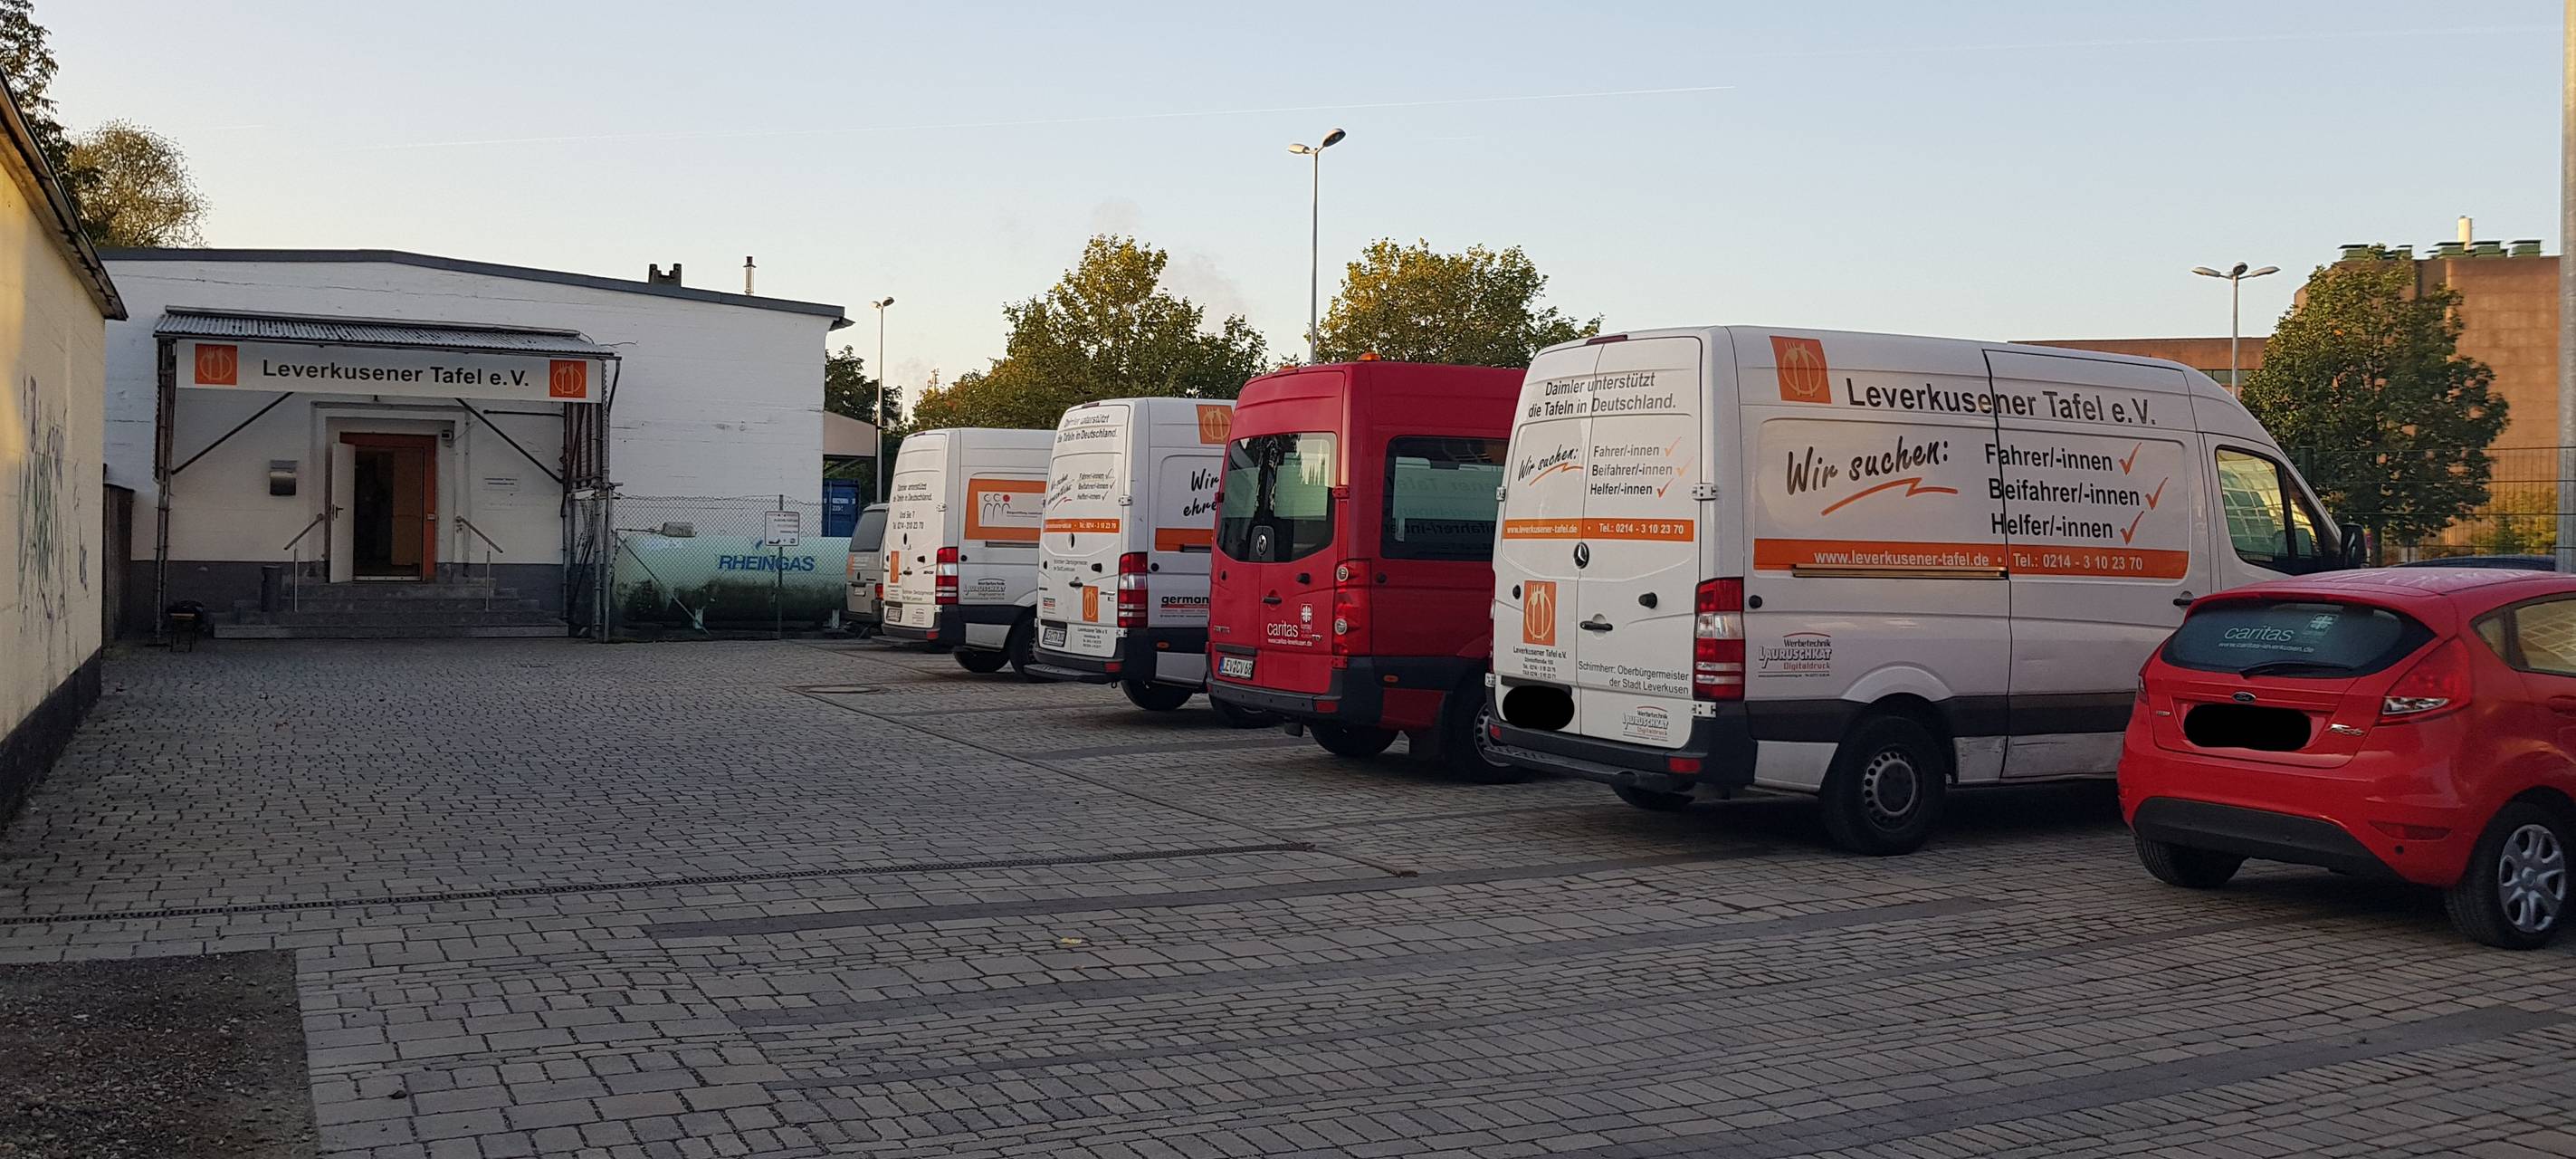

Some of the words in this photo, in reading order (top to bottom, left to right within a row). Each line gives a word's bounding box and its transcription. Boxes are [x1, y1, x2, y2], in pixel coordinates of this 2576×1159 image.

[262, 359, 424, 383] Leverkusener
[430, 366, 482, 385] Tafel
[490, 369, 530, 387] e.V.
[1545, 379, 1589, 397] Daimler
[1588, 372, 1655, 392] unterstützt
[1528, 403, 1541, 418] die
[1544, 400, 1573, 417] Tafeln
[1577, 399, 1587, 414] in
[1592, 393, 1676, 413] Deutschland.
[1846, 378, 2037, 417] Leverkusener
[2042, 390, 2104, 421] Tafel
[2112, 398, 2157, 425] e.V.
[1593, 445, 1659, 457] Fahrer/-innen
[1985, 443, 2113, 471] Fahrer/-innen
[1518, 455, 1535, 482] Wir
[1538, 444, 1579, 471] suchen:
[1592, 464, 1673, 476] Beifahrer/-innen
[1787, 446, 1838, 495] Wir
[1849, 436, 1949, 481] suchen:
[1190, 468, 1219, 492] Wir
[1590, 483, 1653, 495] Helfer/-innen
[1989, 477, 2140, 506] Beifahrer/-innen
[1183, 497, 1217, 516] ehre
[1599, 522, 1614, 532] Tel.:
[1616, 523, 1633, 533] 0214
[1641, 523, 1646, 533] 3
[1649, 524, 1657, 534] 10
[1660, 524, 1670, 534] 23
[1674, 524, 1684, 534] 70
[1991, 512, 2113, 539] Helfer/-innen
[718, 555, 815, 571] RHEINGAS
[1814, 550, 1989, 566] www.leverkusener-tafel.de
[2013, 552, 2038, 568] Tel.:
[2043, 553, 2071, 569] 0214
[2084, 555, 2090, 569] 3
[2094, 555, 2107, 570] 10
[2112, 556, 2125, 570] 23
[2130, 557, 2142, 570] 70
[1161, 596, 1209, 605] german
[1267, 619, 1299, 637] caritas
[2224, 625, 2295, 642] caritas
[1783, 638, 1832, 647] Werbetechnik
[1579, 660, 1616, 674] Schirmherr:
[1617, 665, 1689, 681] Oberbürgermeister
[1783, 662, 1830, 671] Digitaldruck
[1609, 677, 1620, 687] der
[1622, 678, 1641, 689] Stadt
[1643, 681, 1689, 694] Leverkusen
